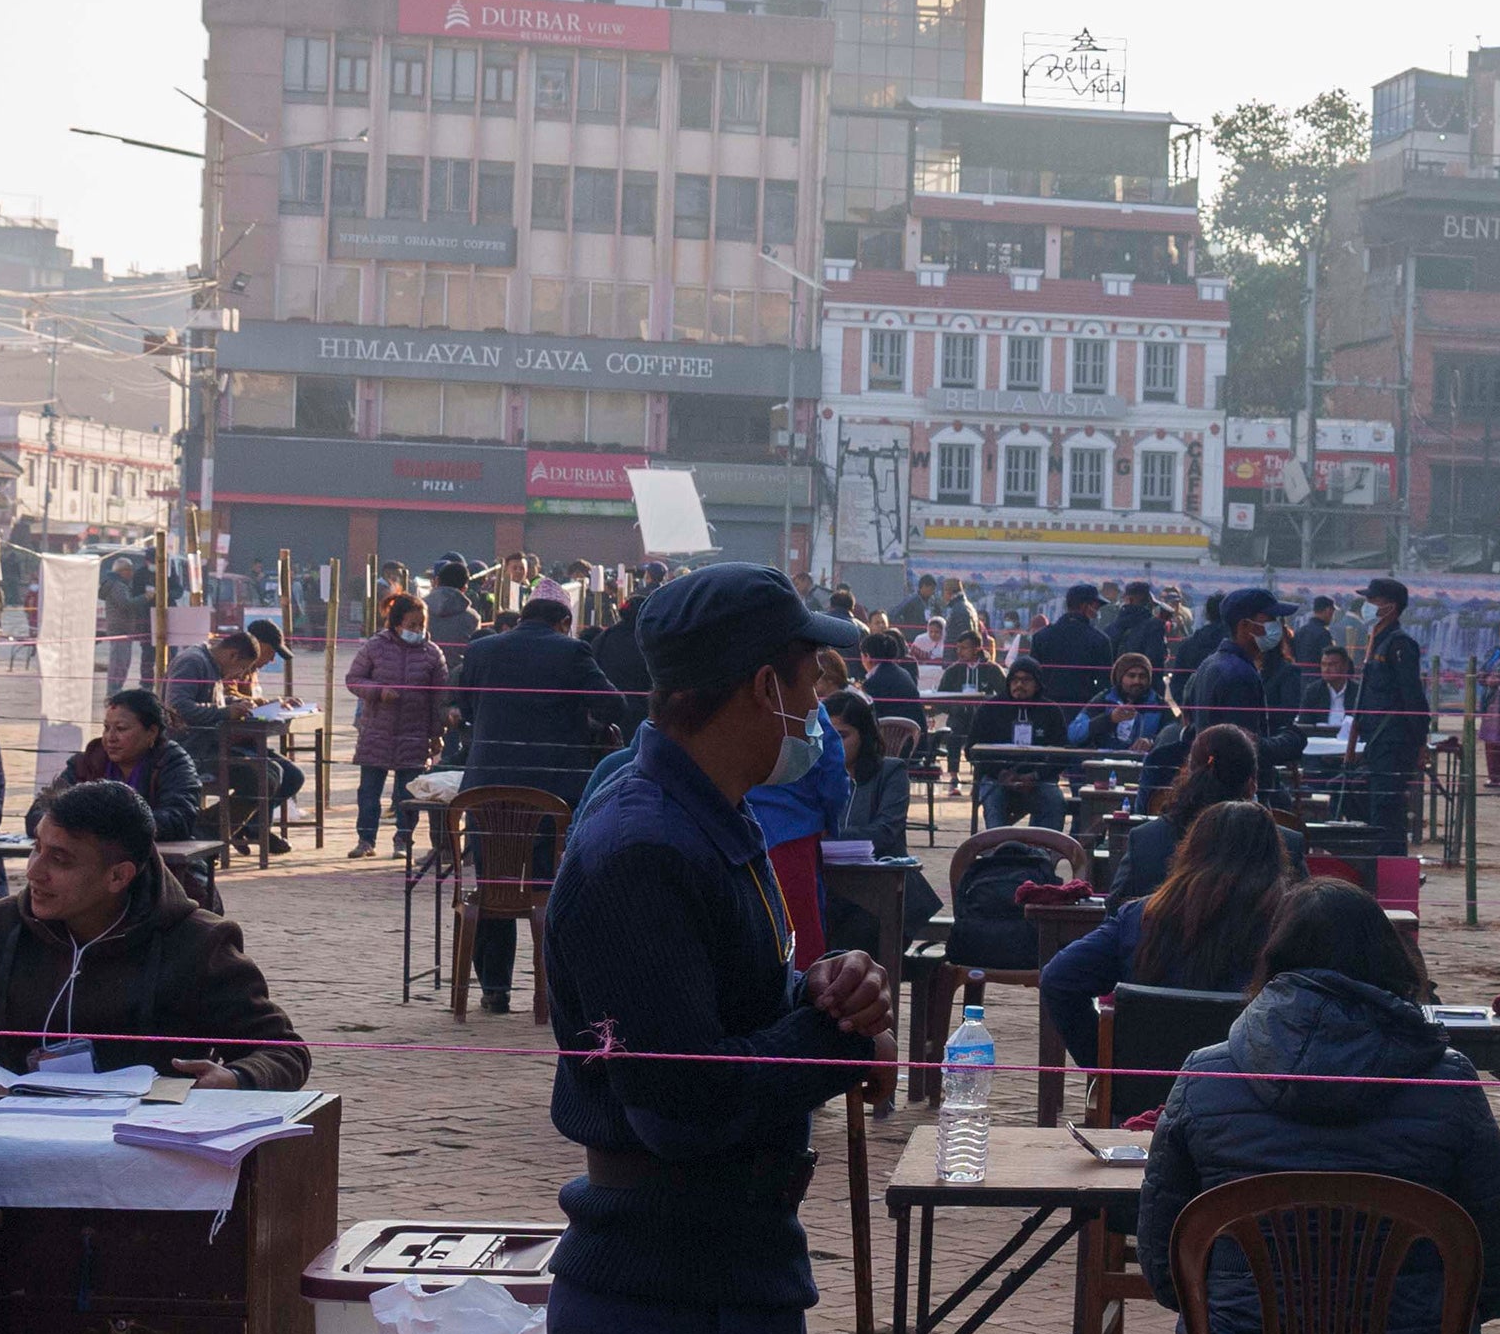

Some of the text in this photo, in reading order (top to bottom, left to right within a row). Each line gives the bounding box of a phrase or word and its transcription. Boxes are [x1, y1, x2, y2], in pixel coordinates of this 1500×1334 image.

[481, 7, 625, 36] DURBAR VIEW
[1068, 64, 1125, 98] Vista
[404, 232, 458, 250] ORGANIC
[463, 236, 507, 252] COFFEE
[317, 336, 714, 380] HIMALAYAN JAVA COFFEE
[944, 391, 1109, 416] BELLA VISTA
[422, 480, 455, 492] PIZZA
[550, 466, 616, 483] DURBAR
[769, 474, 805, 486] HOSE
[1187, 440, 1205, 514] CAFE
